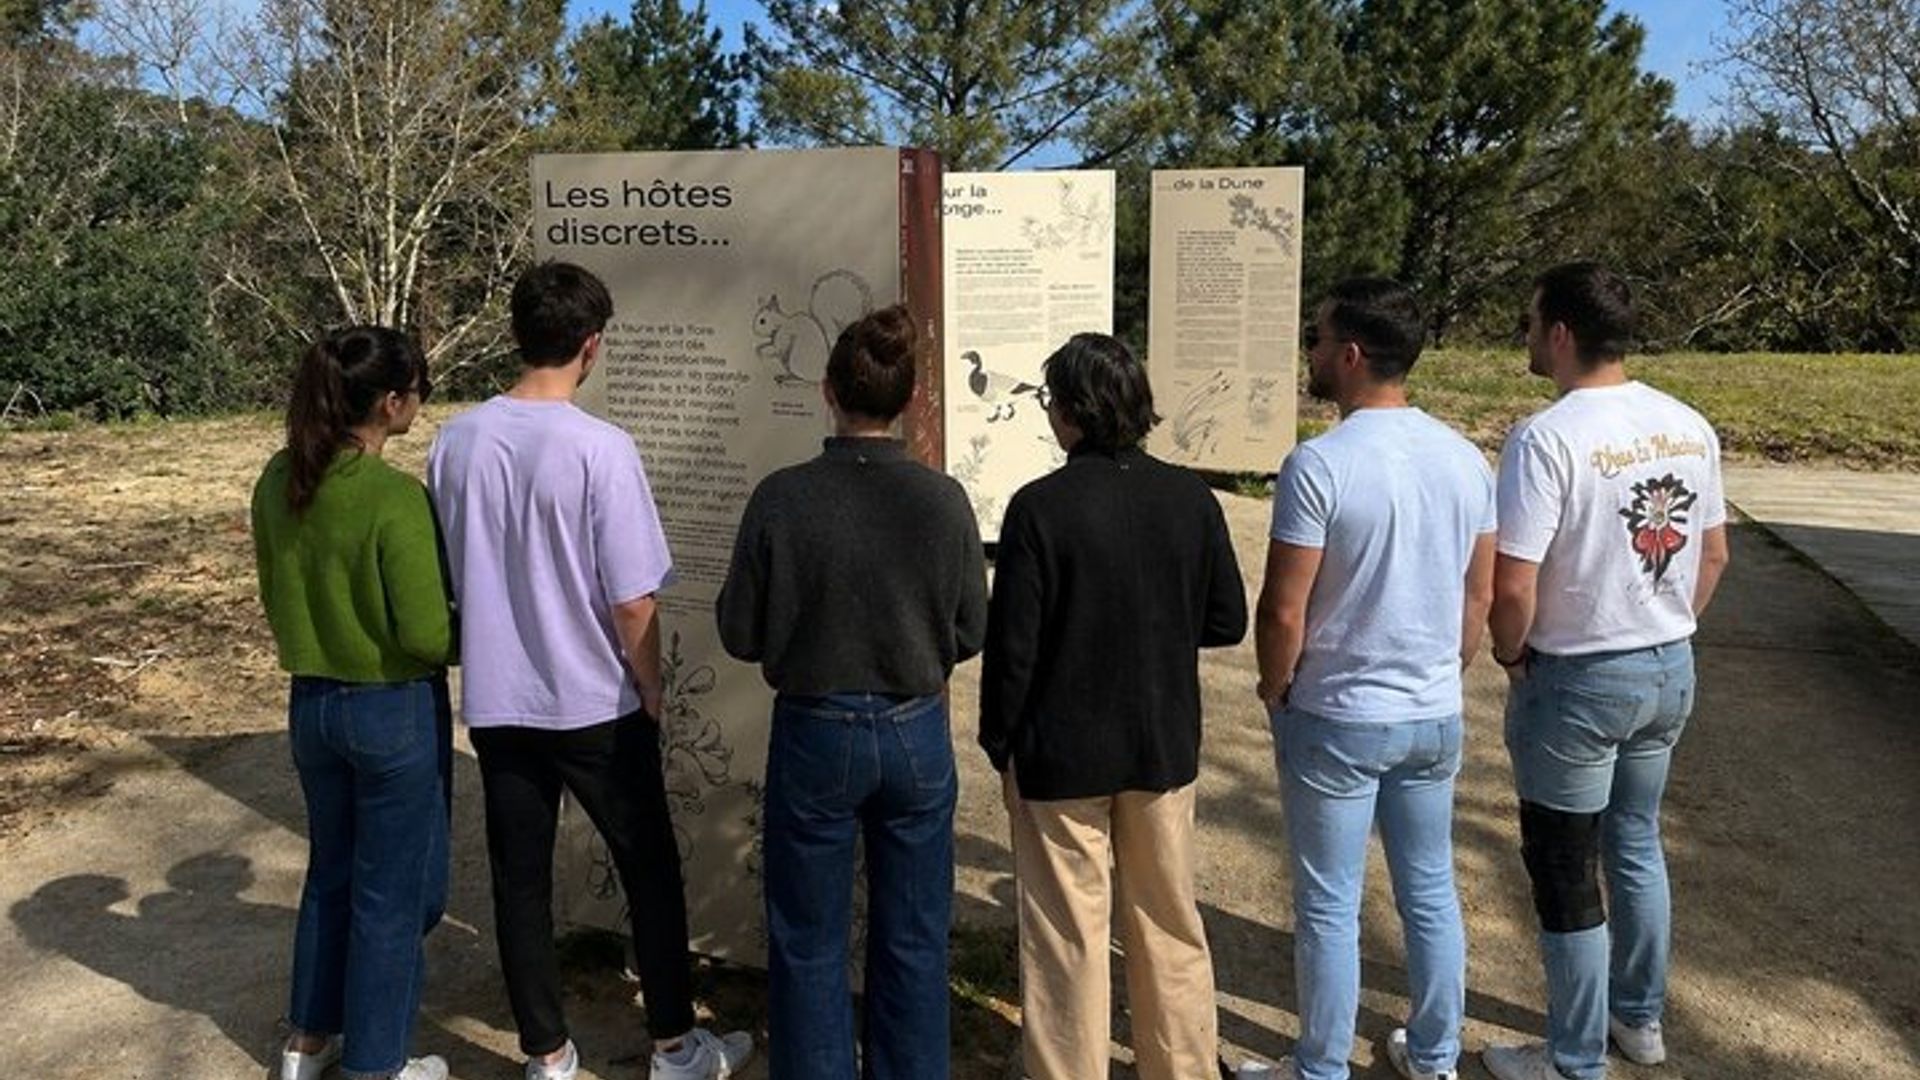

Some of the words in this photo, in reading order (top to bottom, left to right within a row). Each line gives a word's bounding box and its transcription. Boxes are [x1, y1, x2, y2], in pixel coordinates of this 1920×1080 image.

[545, 180, 610, 208] Les
[623, 179, 732, 208] hôtes
[970, 184, 987, 198] la
[1200, 178, 1215, 190] la
[1218, 177, 1264, 190] Dune
[547, 218, 730, 246] discrets...
